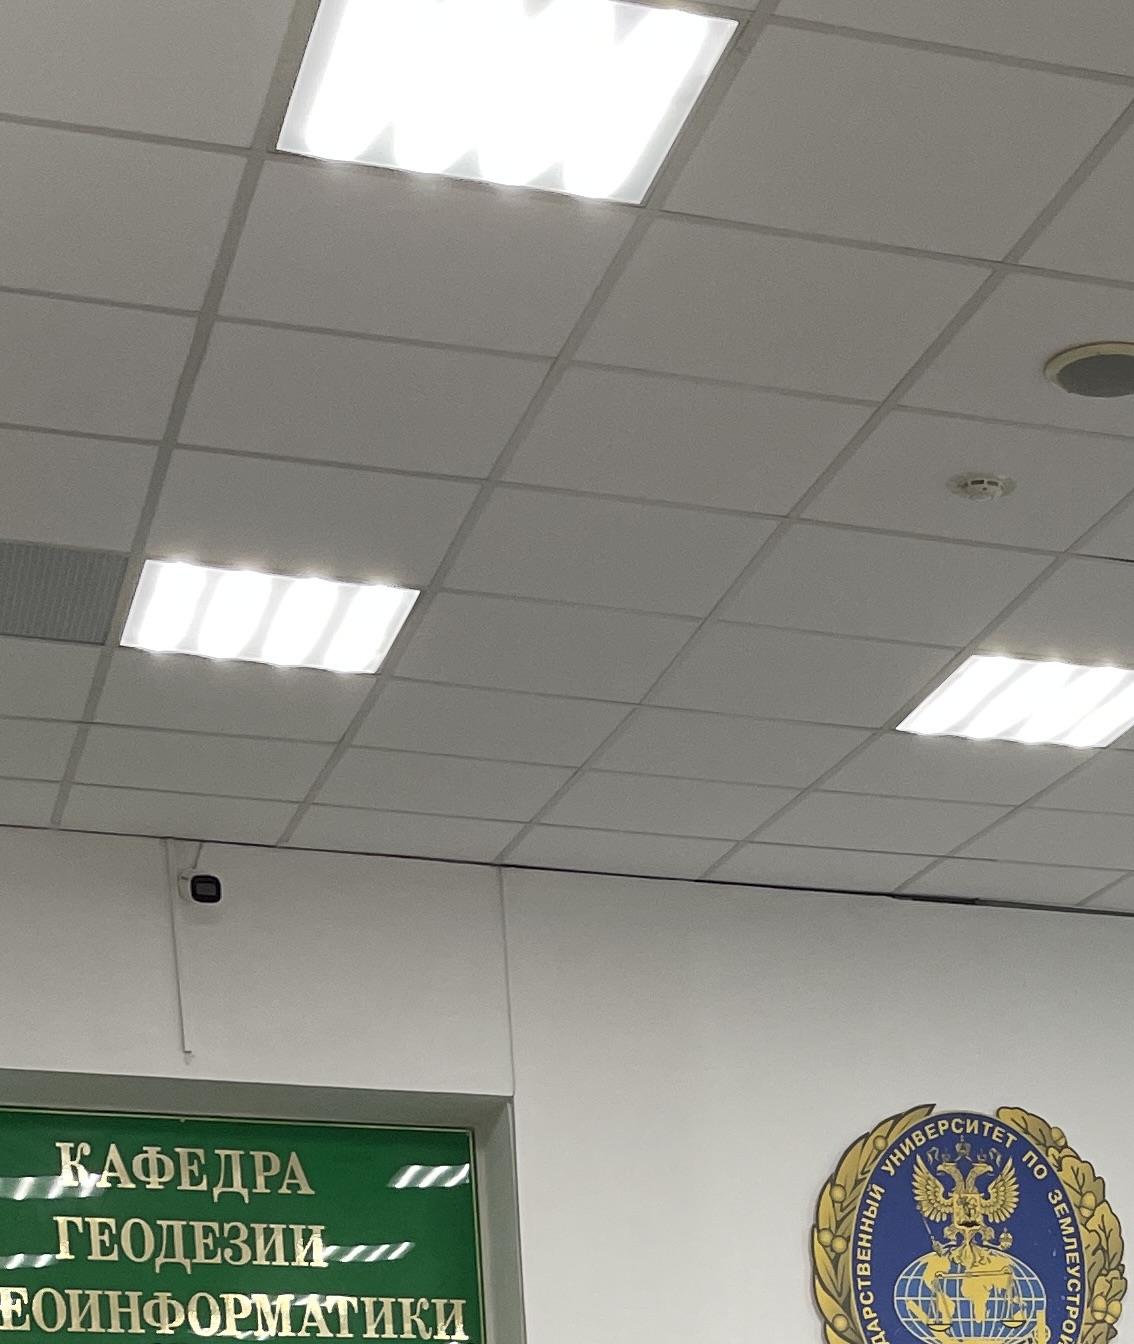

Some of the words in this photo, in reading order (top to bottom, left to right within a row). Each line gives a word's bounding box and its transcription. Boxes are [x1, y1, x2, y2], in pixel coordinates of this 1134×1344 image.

[55, 1141, 315, 1203] КАФЕДРА
[882, 1118, 1017, 1176] УНИВЕРСИТЕТ
[1022, 1151, 1048, 1181] ПО
[53, 1216, 328, 1274] ГЕОДЕЗИИ
[0, 1286, 469, 1341] ЕОИНФОРМАТИКИ
